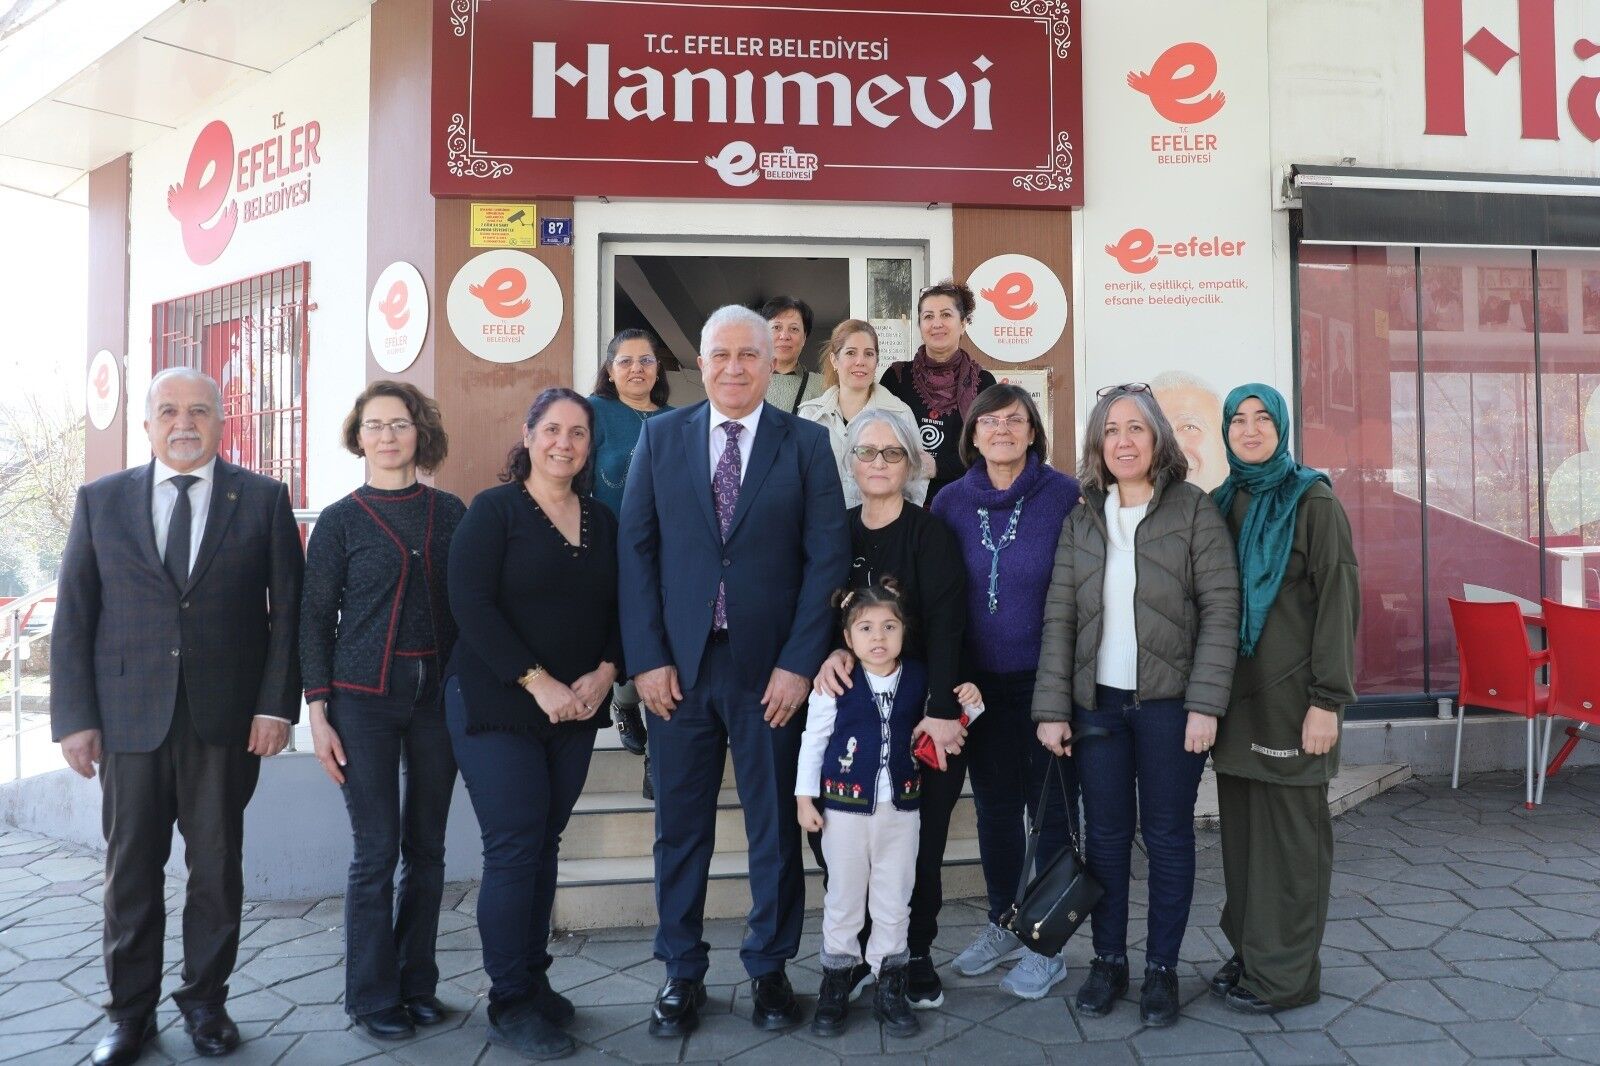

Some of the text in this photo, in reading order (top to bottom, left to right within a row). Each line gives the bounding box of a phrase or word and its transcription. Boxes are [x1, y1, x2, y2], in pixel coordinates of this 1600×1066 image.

[644, 34, 889, 61] T.C. EFELER BELEDİYESİ
[532, 41, 993, 130] Hanımevi
[1151, 134, 1218, 152] EFELER
[237, 120, 321, 193] EFELER
[761, 154, 817, 169] EFELER
[1158, 152, 1211, 164] BELEDİYESİ
[766, 170, 811, 179] BELEDİYESİ
[243, 172, 312, 224] BELEDİYESİ
[548, 221, 563, 234] 87
[1104, 278, 1248, 293] enerjik, eşitlikçi, empatik,
[1104, 294, 1223, 306] efsane belediyecilik.
[482, 324, 525, 335] EFELER
[994, 326, 1033, 337] EFELER
